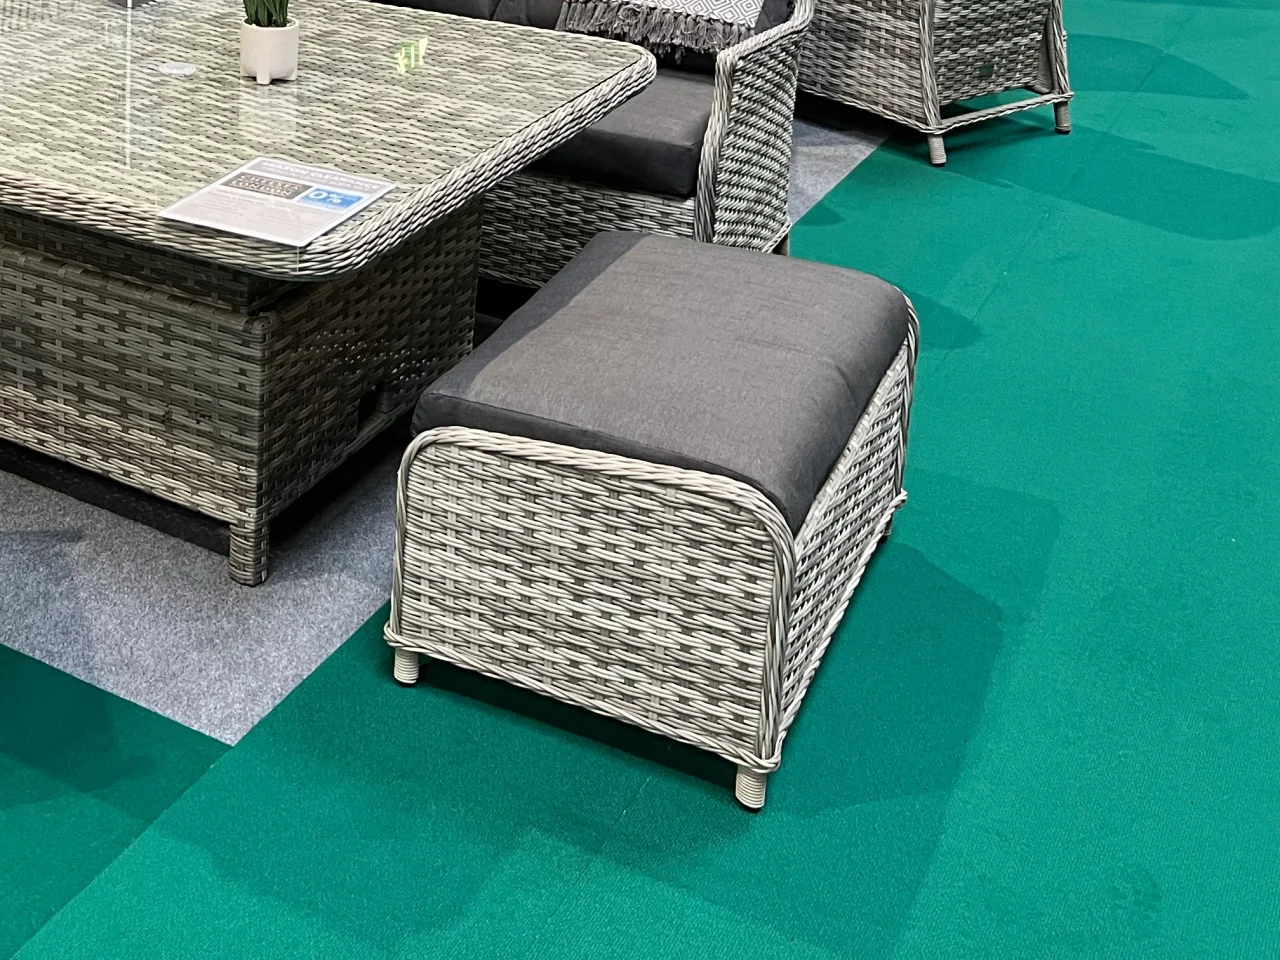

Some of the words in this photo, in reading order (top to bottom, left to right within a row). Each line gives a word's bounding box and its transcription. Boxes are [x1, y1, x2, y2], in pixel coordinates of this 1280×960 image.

[239, 175, 300, 191] CHELSEA
[261, 161, 306, 175] SEASON
[307, 170, 381, 190] CLEARANCE
[231, 180, 292, 196] LONDON
[308, 190, 341, 203] 0%
